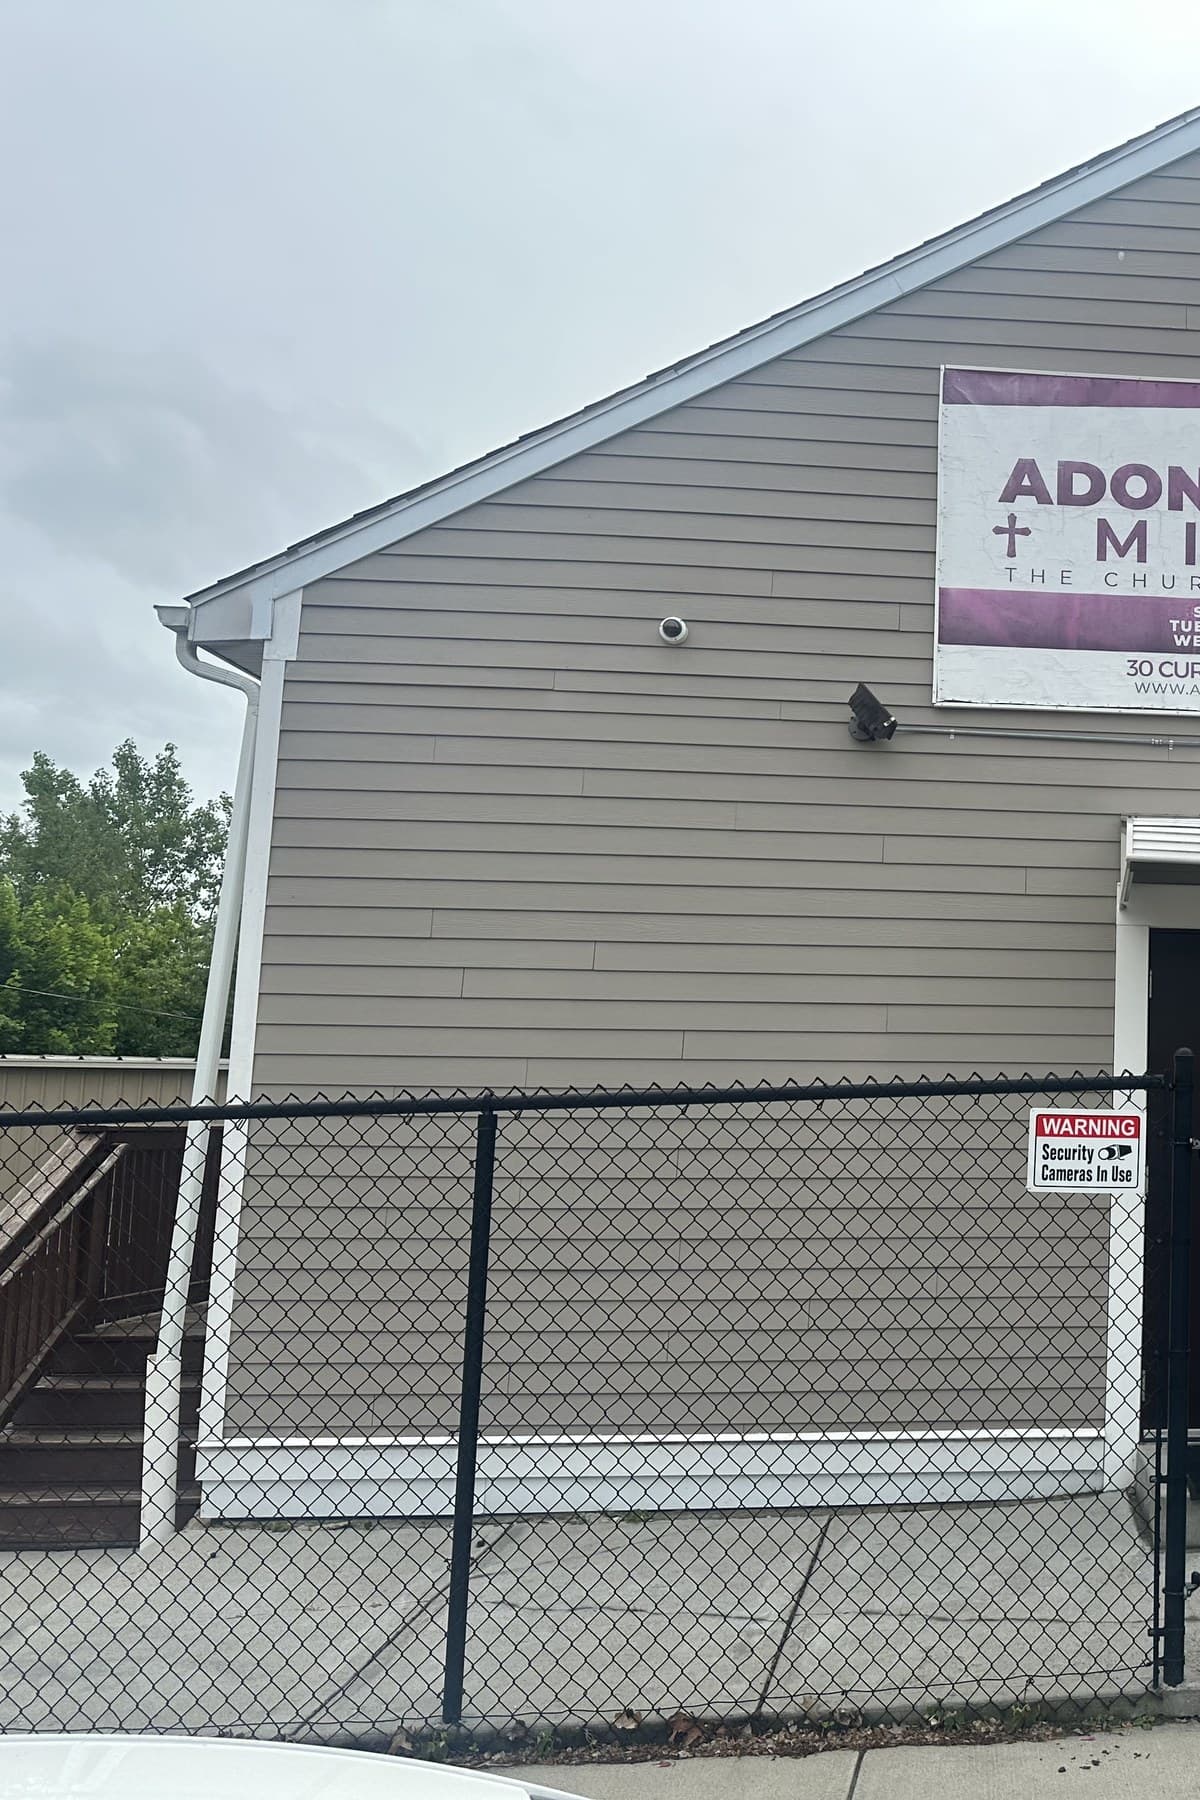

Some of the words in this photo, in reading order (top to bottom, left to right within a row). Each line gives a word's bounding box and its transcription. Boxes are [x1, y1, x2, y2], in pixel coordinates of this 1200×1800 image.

[1005, 567, 1073, 586] THE
[1126, 659, 1154, 677] 30
[1042, 1118, 1135, 1136] WARNING
[1042, 1143, 1094, 1164] Security
[1041, 1164, 1092, 1182] Cameras
[1097, 1165, 1107, 1182] In
[1111, 1166, 1132, 1182] Use
